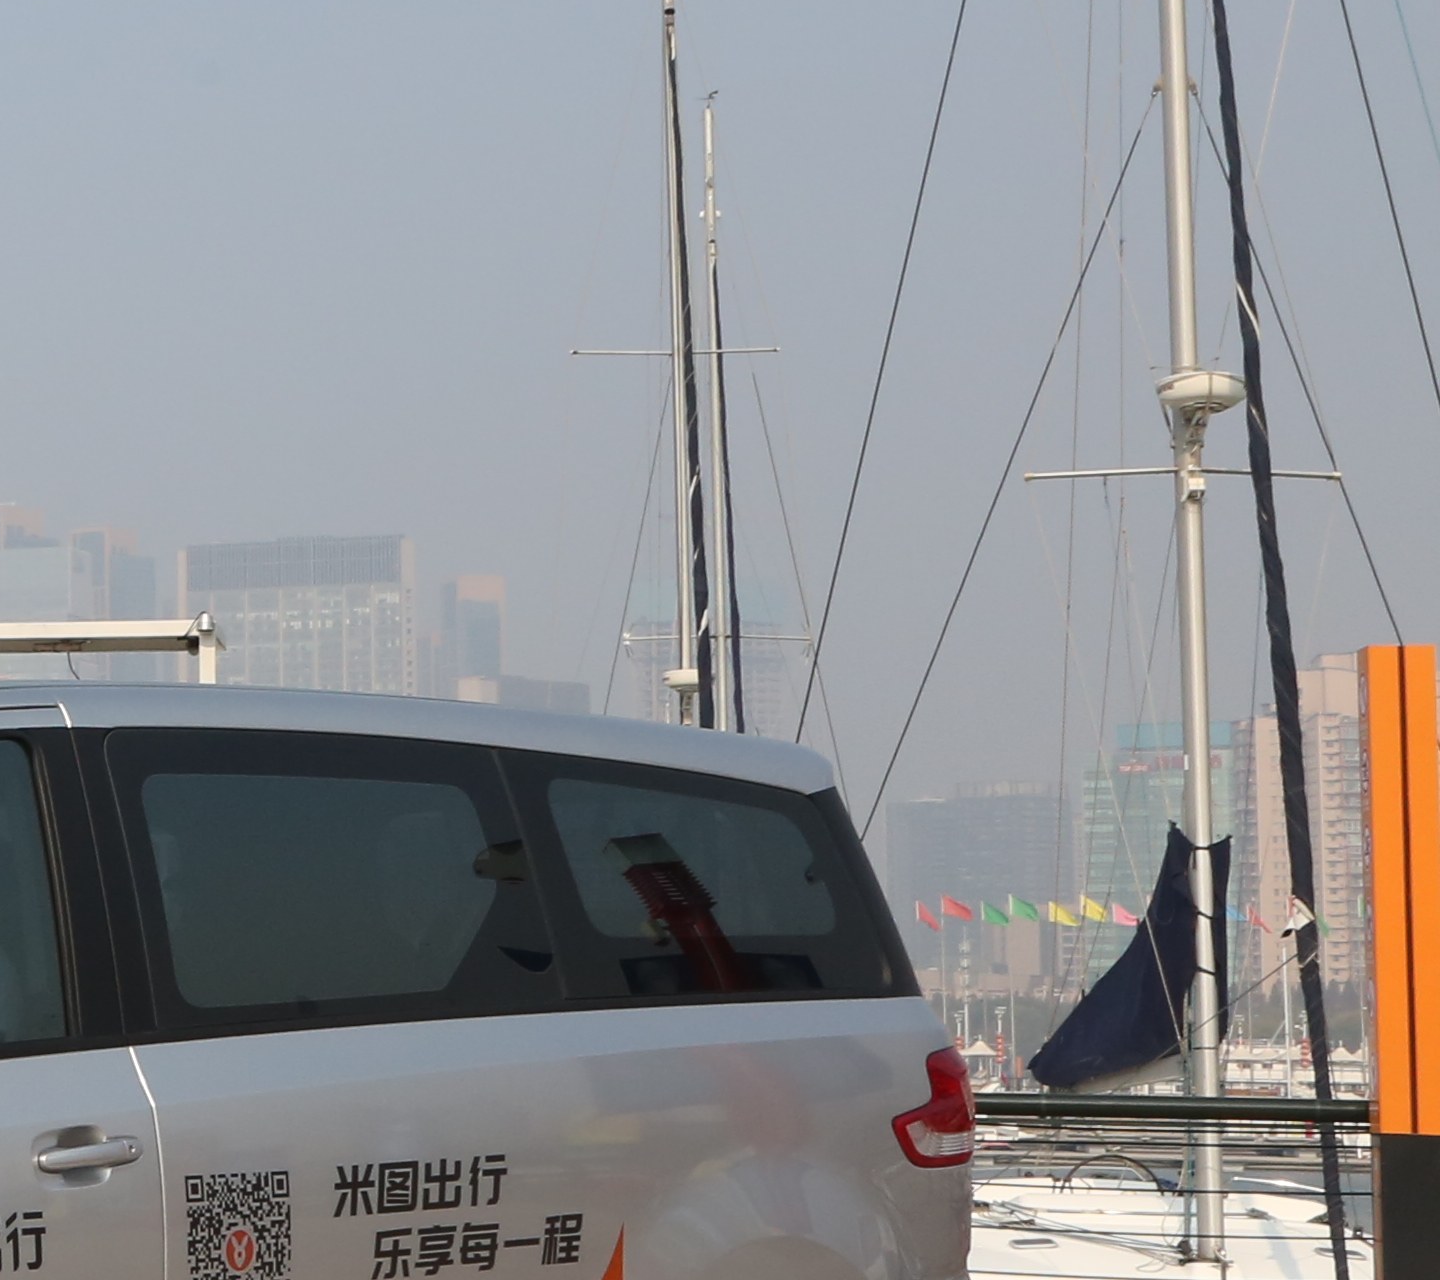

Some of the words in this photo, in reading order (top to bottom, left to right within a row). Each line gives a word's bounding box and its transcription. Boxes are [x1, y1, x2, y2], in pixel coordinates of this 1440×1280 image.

[333, 1154, 508, 1218] 米图出行
[371, 1213, 583, 1280] 乐享每一程
